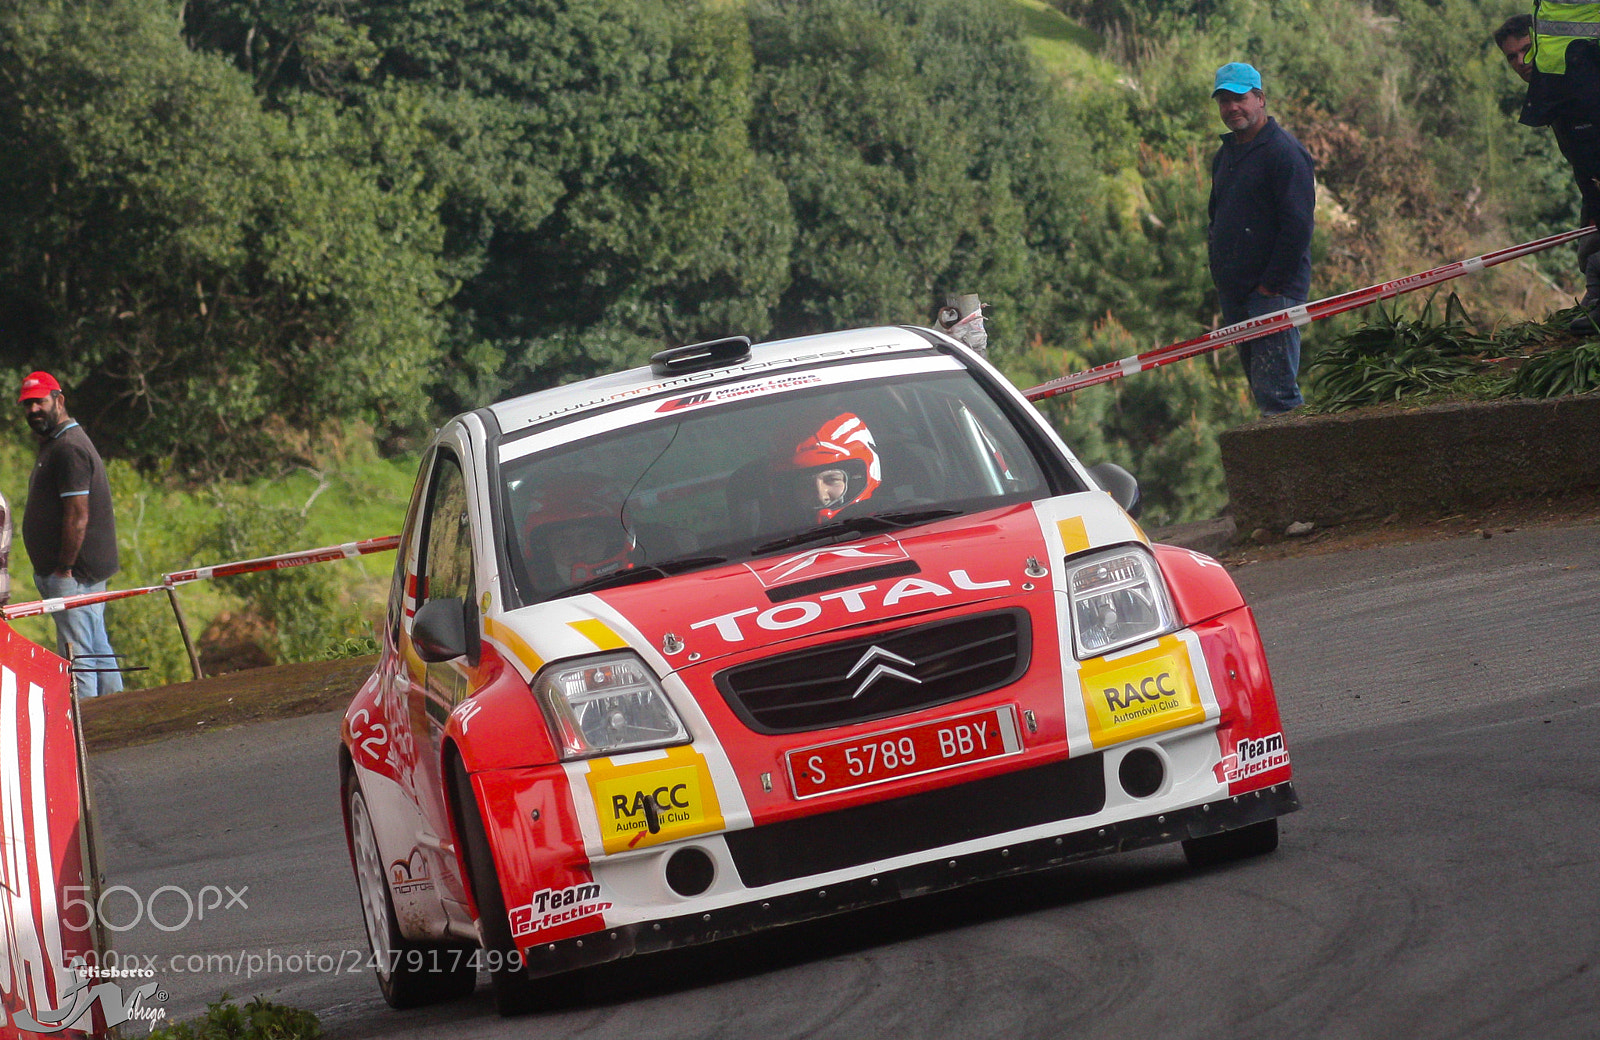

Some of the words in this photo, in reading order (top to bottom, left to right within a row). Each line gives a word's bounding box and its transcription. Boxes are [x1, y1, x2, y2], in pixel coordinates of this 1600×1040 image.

[715, 383, 763, 395] Motor
[768, 374, 816, 385] Lobos
[690, 570, 1012, 643] TOTAL
[1103, 672, 1176, 712] RACC
[1159, 699, 1179, 711] Club
[349, 708, 388, 761] C2
[1239, 734, 1283, 762] Team
[807, 756, 826, 784] S
[845, 737, 917, 777] 5789
[937, 720, 988, 758] BBY
[1212, 752, 1290, 785] Perfection
[611, 783, 690, 820] RACC
[615, 816, 666, 832] Automil
[667, 811, 691, 824] Club
[534, 884, 601, 914] Team
[509, 902, 613, 936] Perfection
